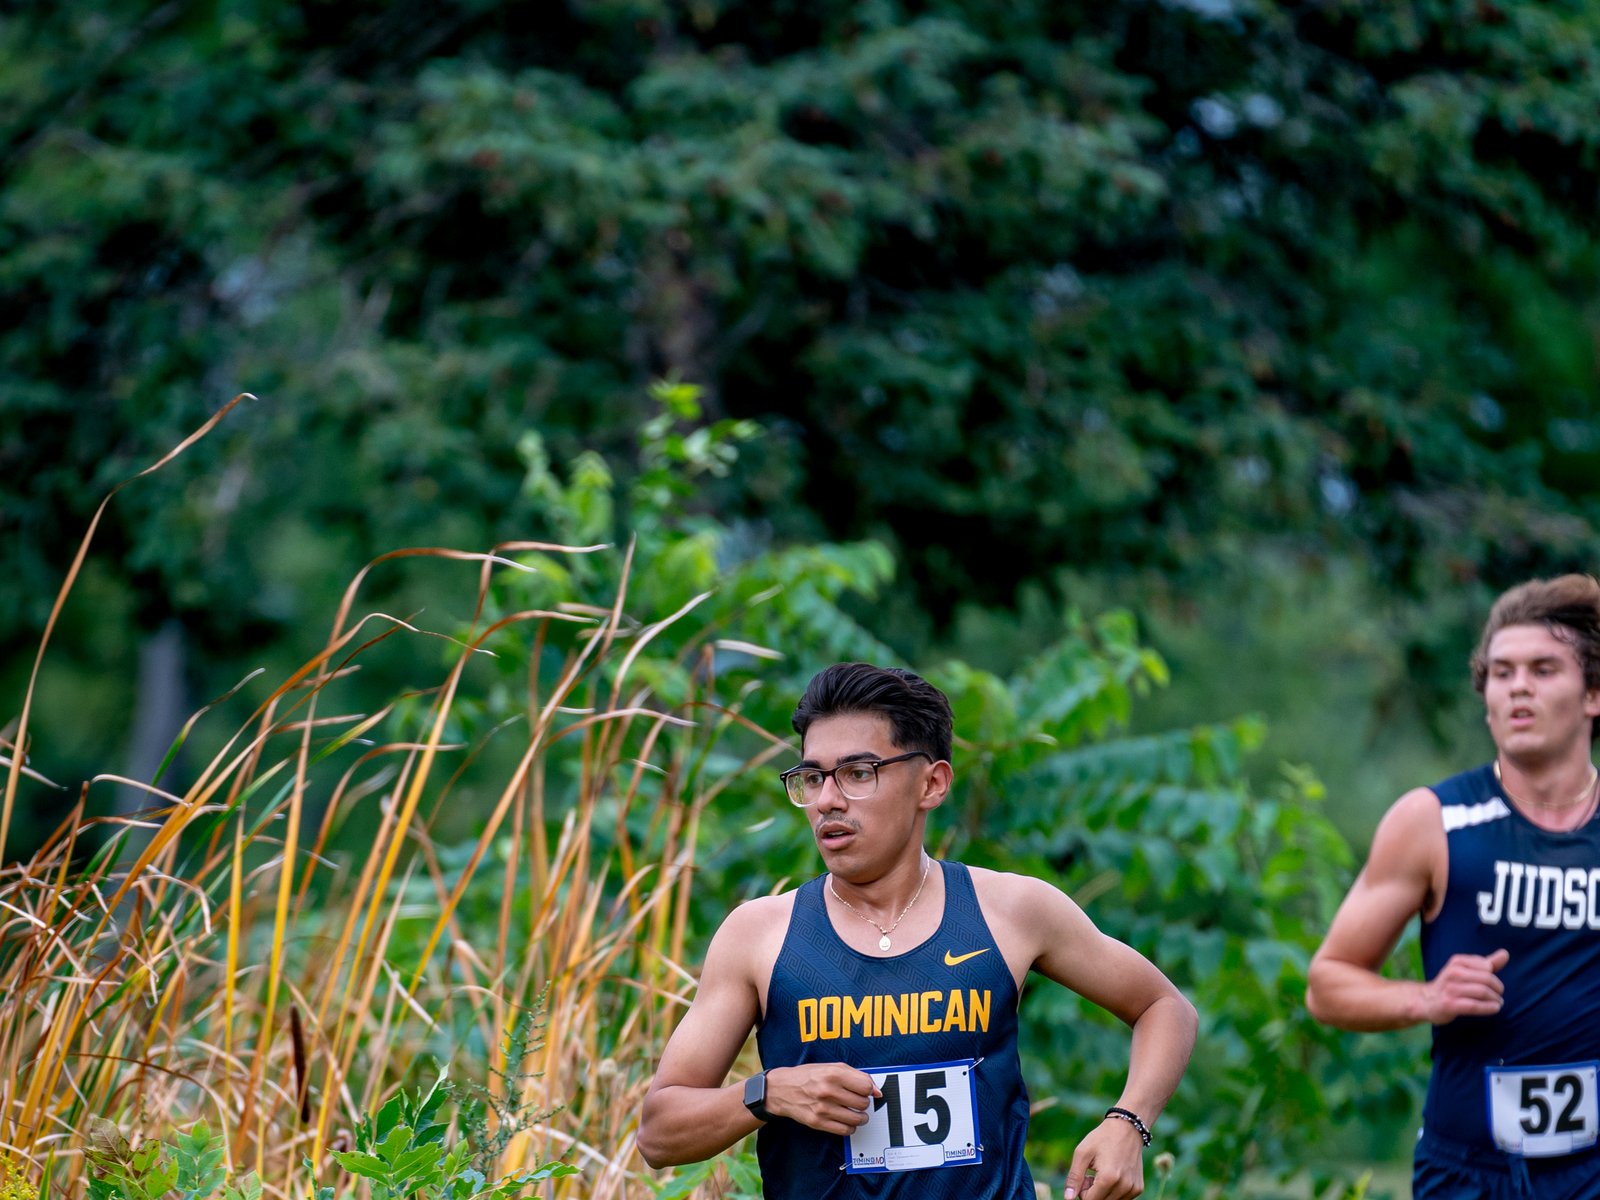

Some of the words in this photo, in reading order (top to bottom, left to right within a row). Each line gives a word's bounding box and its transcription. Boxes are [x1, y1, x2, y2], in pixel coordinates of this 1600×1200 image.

[797, 988, 991, 1043] DOMINICAN
[873, 1070, 951, 1148] 15
[1519, 1073, 1585, 1135] 52
